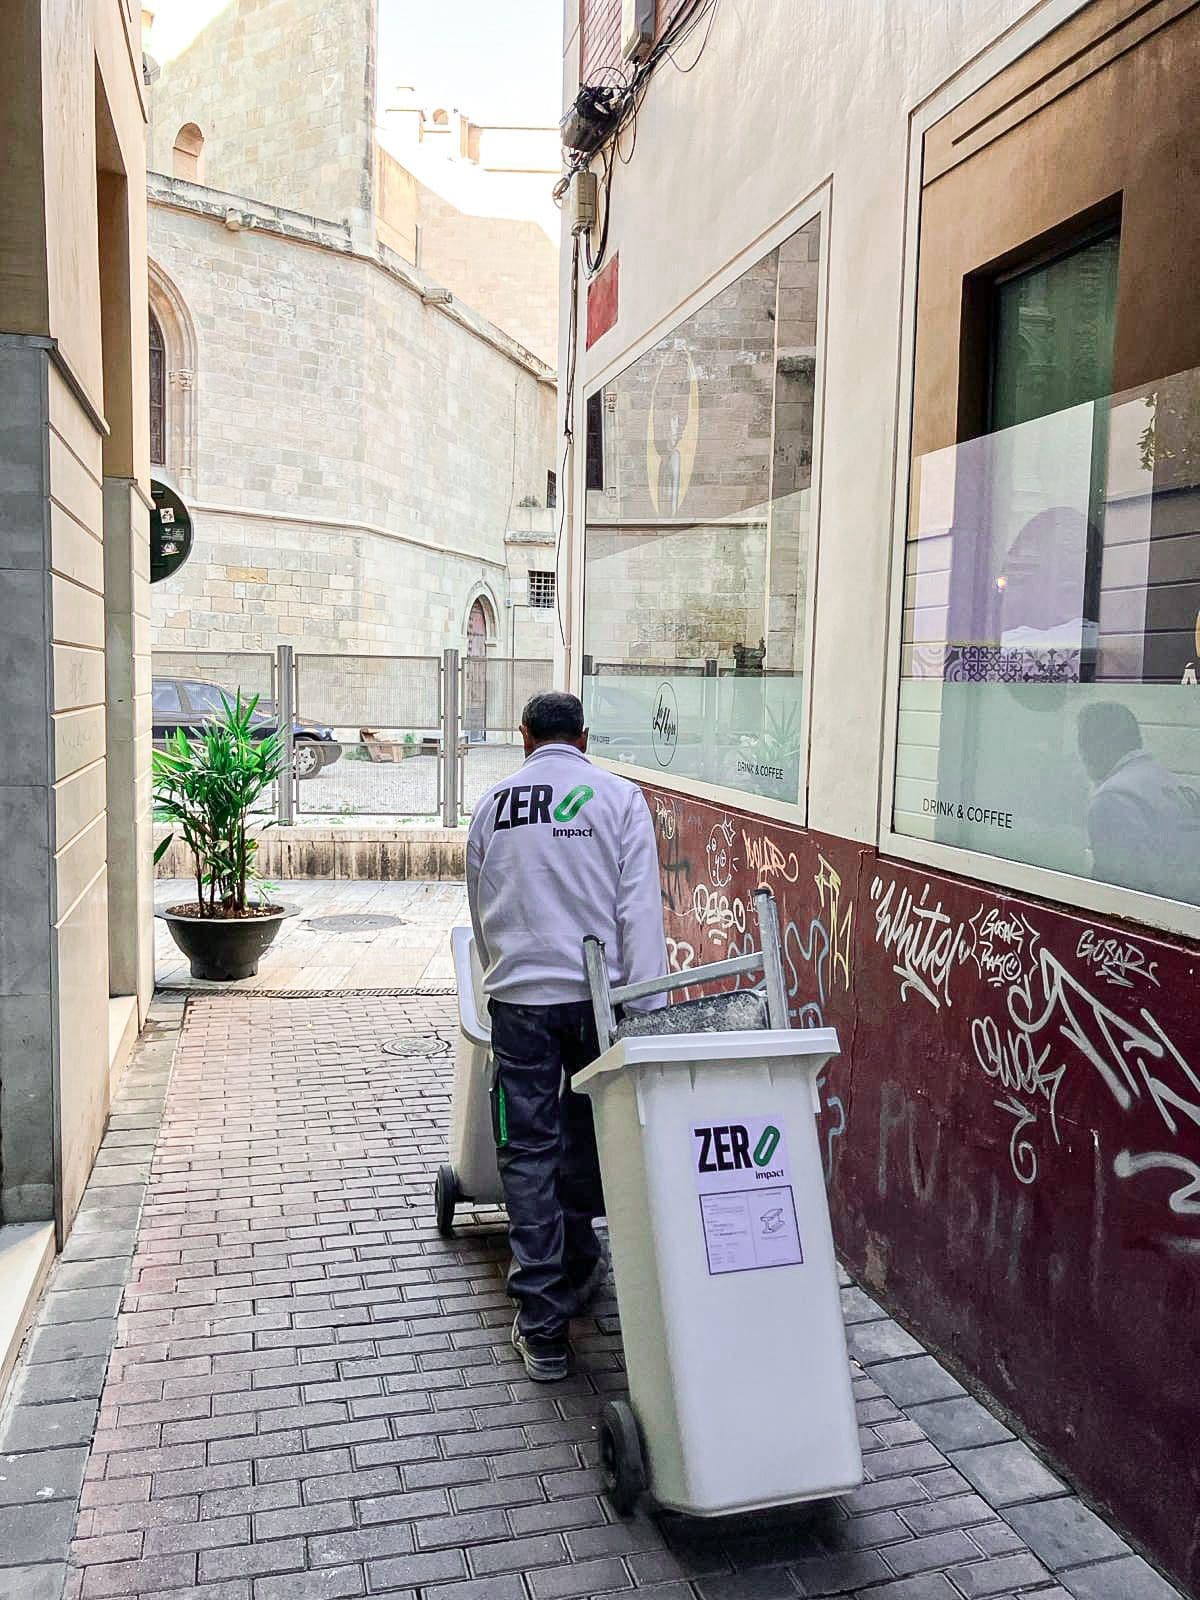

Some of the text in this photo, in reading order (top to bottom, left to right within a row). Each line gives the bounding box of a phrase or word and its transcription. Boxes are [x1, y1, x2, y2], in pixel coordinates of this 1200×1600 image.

[760, 765, 784, 780] COFFEE
[493, 784, 594, 832] ZERO
[922, 798, 1013, 829] DRINK & COFFEE
[694, 1125, 780, 1173] ZERO
